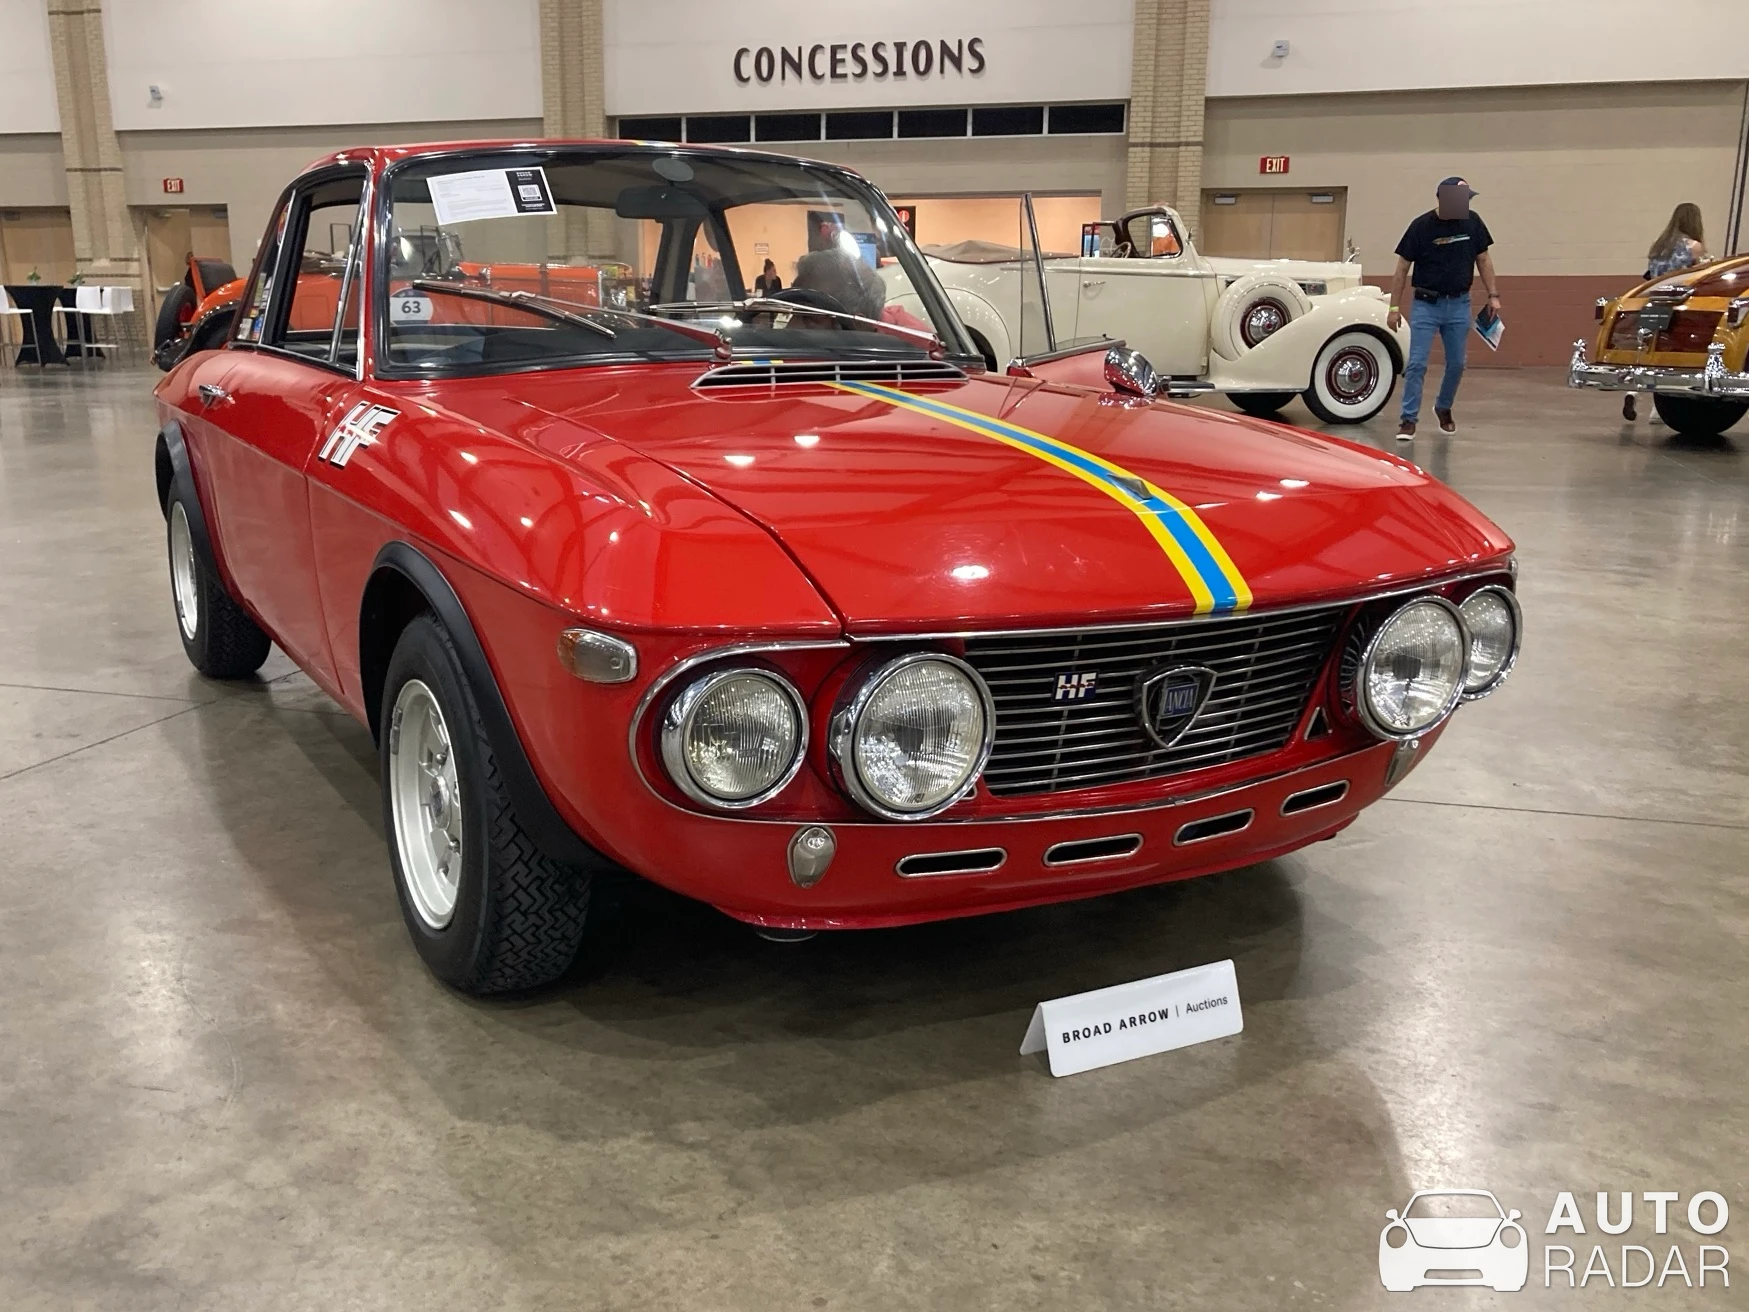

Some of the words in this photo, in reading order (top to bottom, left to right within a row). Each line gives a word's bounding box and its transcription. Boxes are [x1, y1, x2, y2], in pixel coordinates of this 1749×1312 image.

[733, 37, 986, 83] CONCESSIONS
[1266, 158, 1286, 173] EXIT
[401, 300, 422, 314] 63
[317, 400, 402, 471] HF
[1055, 672, 1097, 700] HF
[1062, 1022, 1112, 1043] BROAD
[1119, 1008, 1169, 1030] ARROW
[1186, 996, 1228, 1015] Auctions
